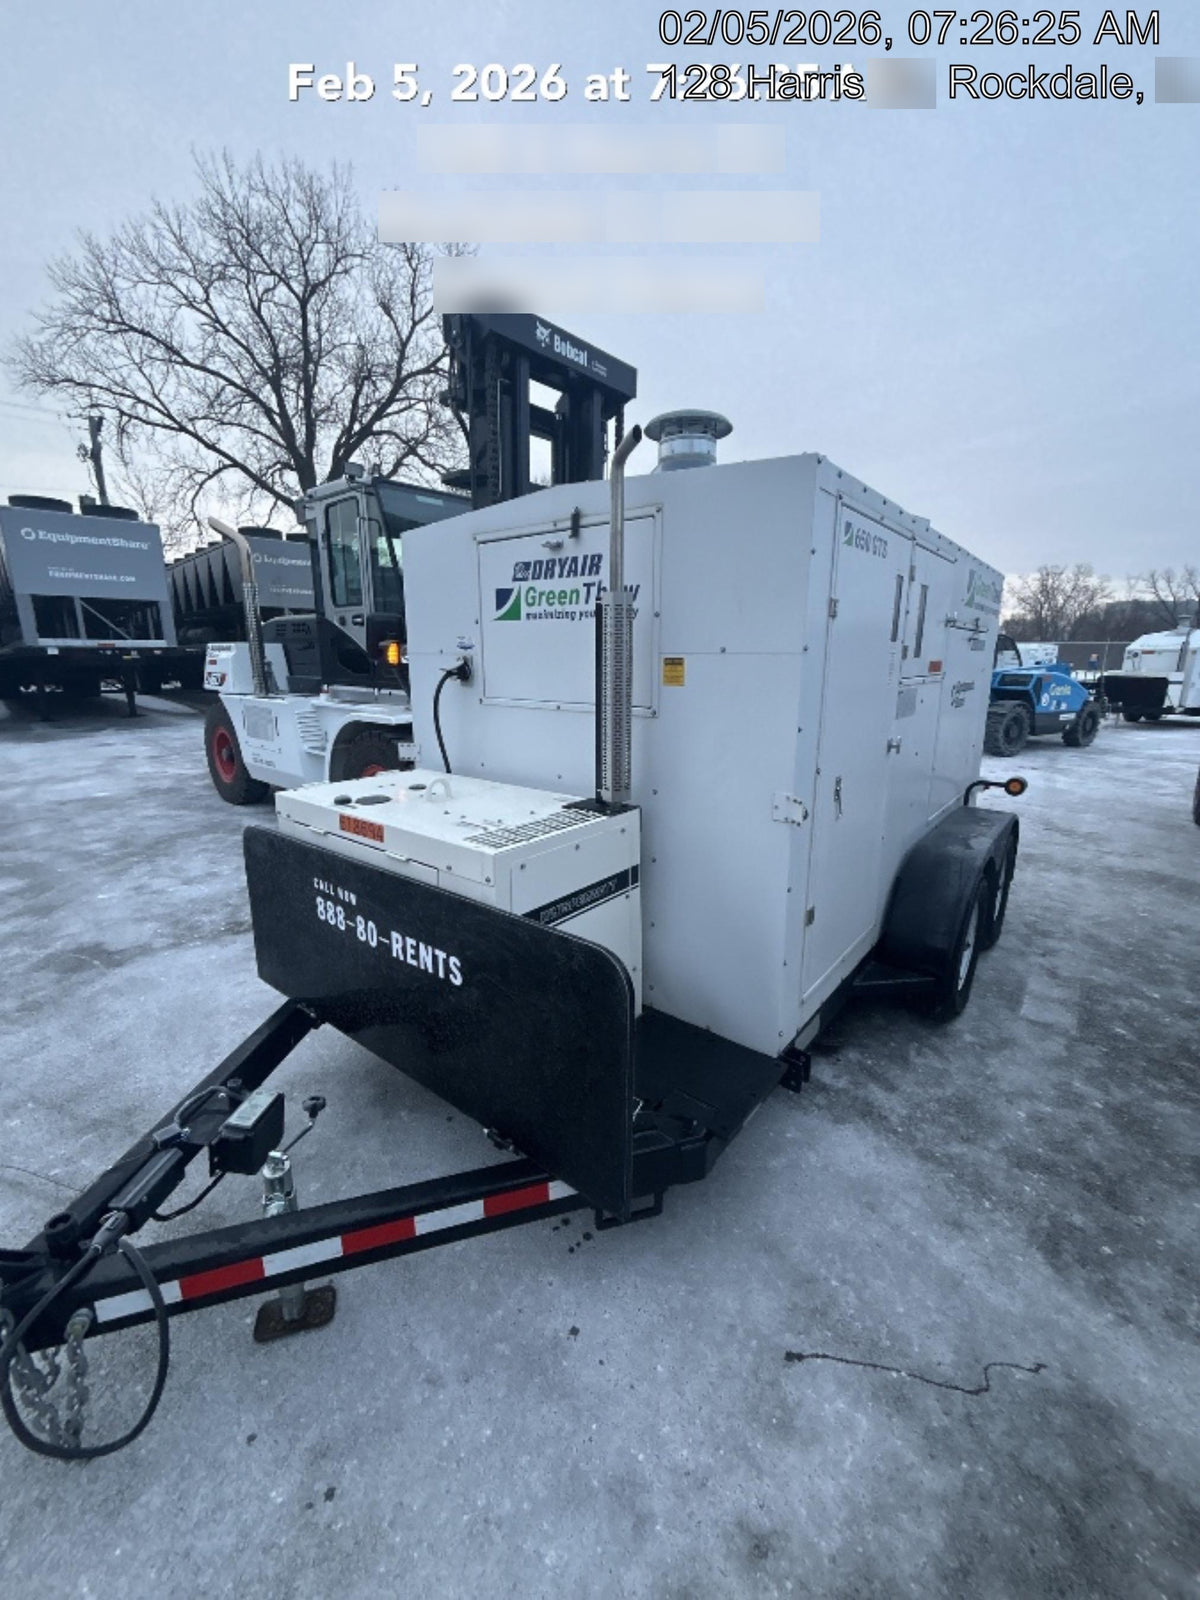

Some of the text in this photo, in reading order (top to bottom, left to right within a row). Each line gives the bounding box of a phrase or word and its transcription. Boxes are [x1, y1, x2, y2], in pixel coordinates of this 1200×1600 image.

[554, 333, 588, 367] Bobcat
[38, 529, 149, 550] EquipmentShare
[531, 553, 603, 581] DRYAIR
[525, 581, 640, 607] GreenThw
[313, 877, 357, 906] CALL NOW
[316, 895, 463, 986] 888-80-RENTS
